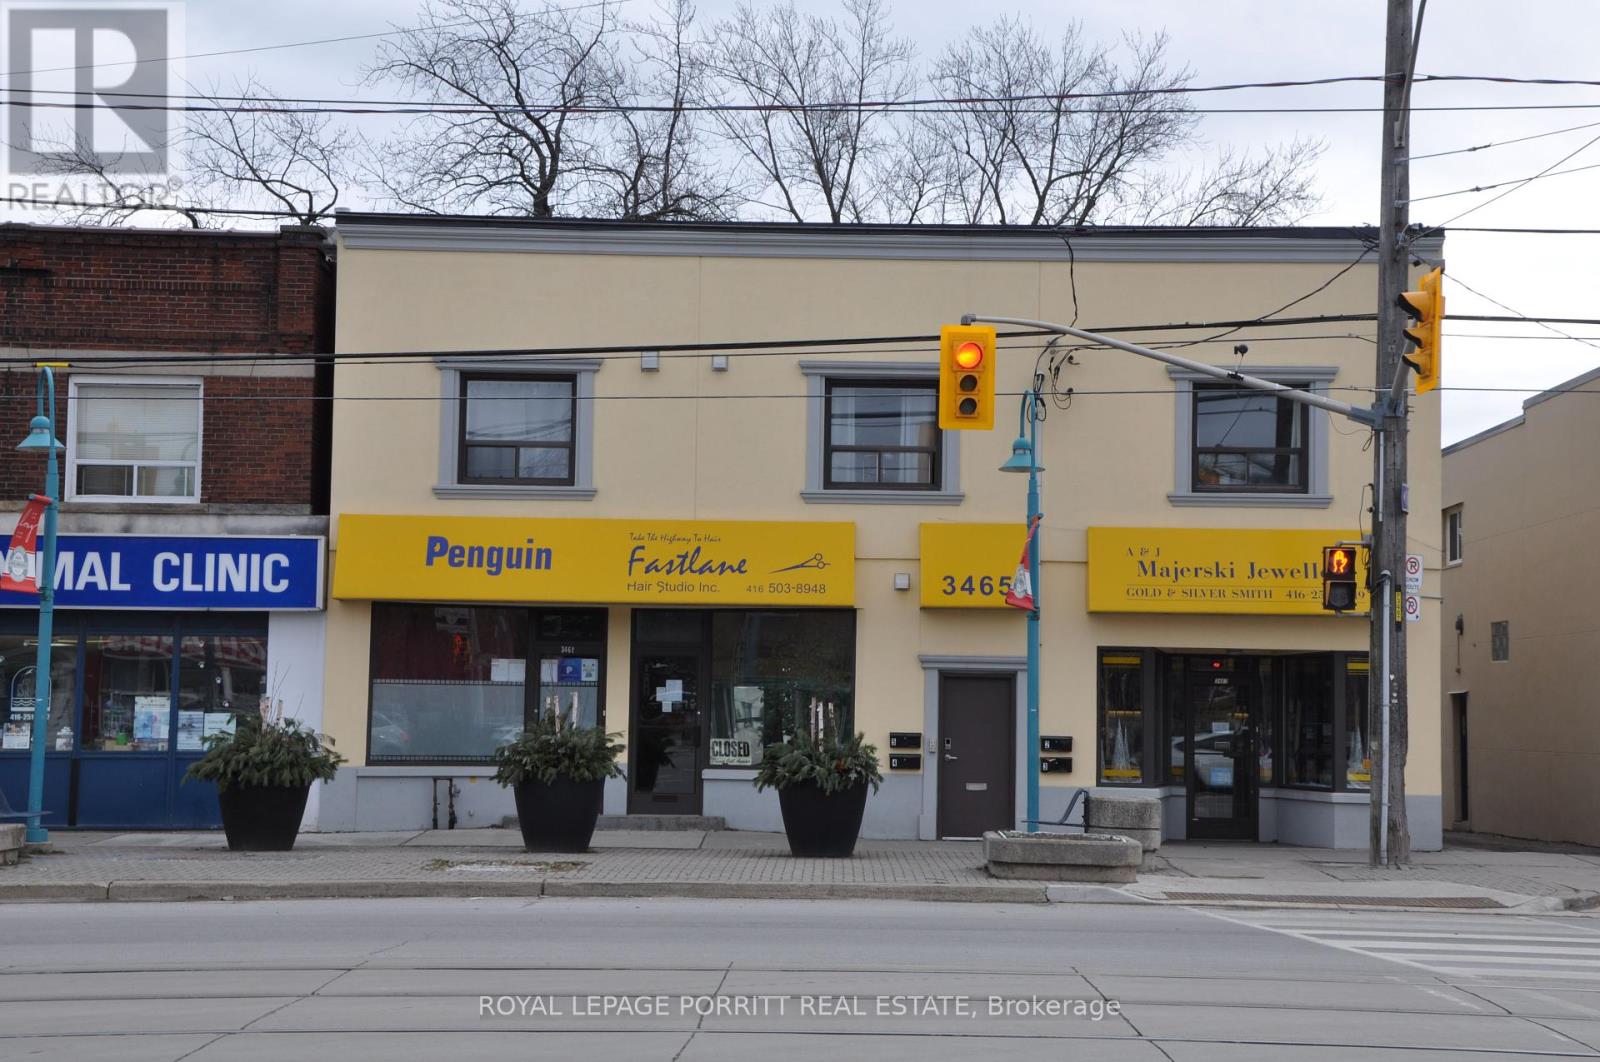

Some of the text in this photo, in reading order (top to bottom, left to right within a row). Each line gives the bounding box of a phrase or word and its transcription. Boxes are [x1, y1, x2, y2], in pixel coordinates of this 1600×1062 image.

[426, 536, 553, 576] Penguin
[628, 545, 748, 576] Fastlane
[1126, 547, 1134, 557] A
[152, 552, 290, 593] CLINIC
[1137, 560, 1235, 583] Majerski
[627, 581, 720, 593] Hair Studio Inc.
[746, 583, 826, 594] 416 503-8948
[942, 575, 1012, 596] 3465
[1126, 587, 1161, 597] GOLD
[1182, 588, 1225, 598] SILVER
[1232, 589, 1272, 599] SMITH
[711, 740, 750, 757] CLOSED
